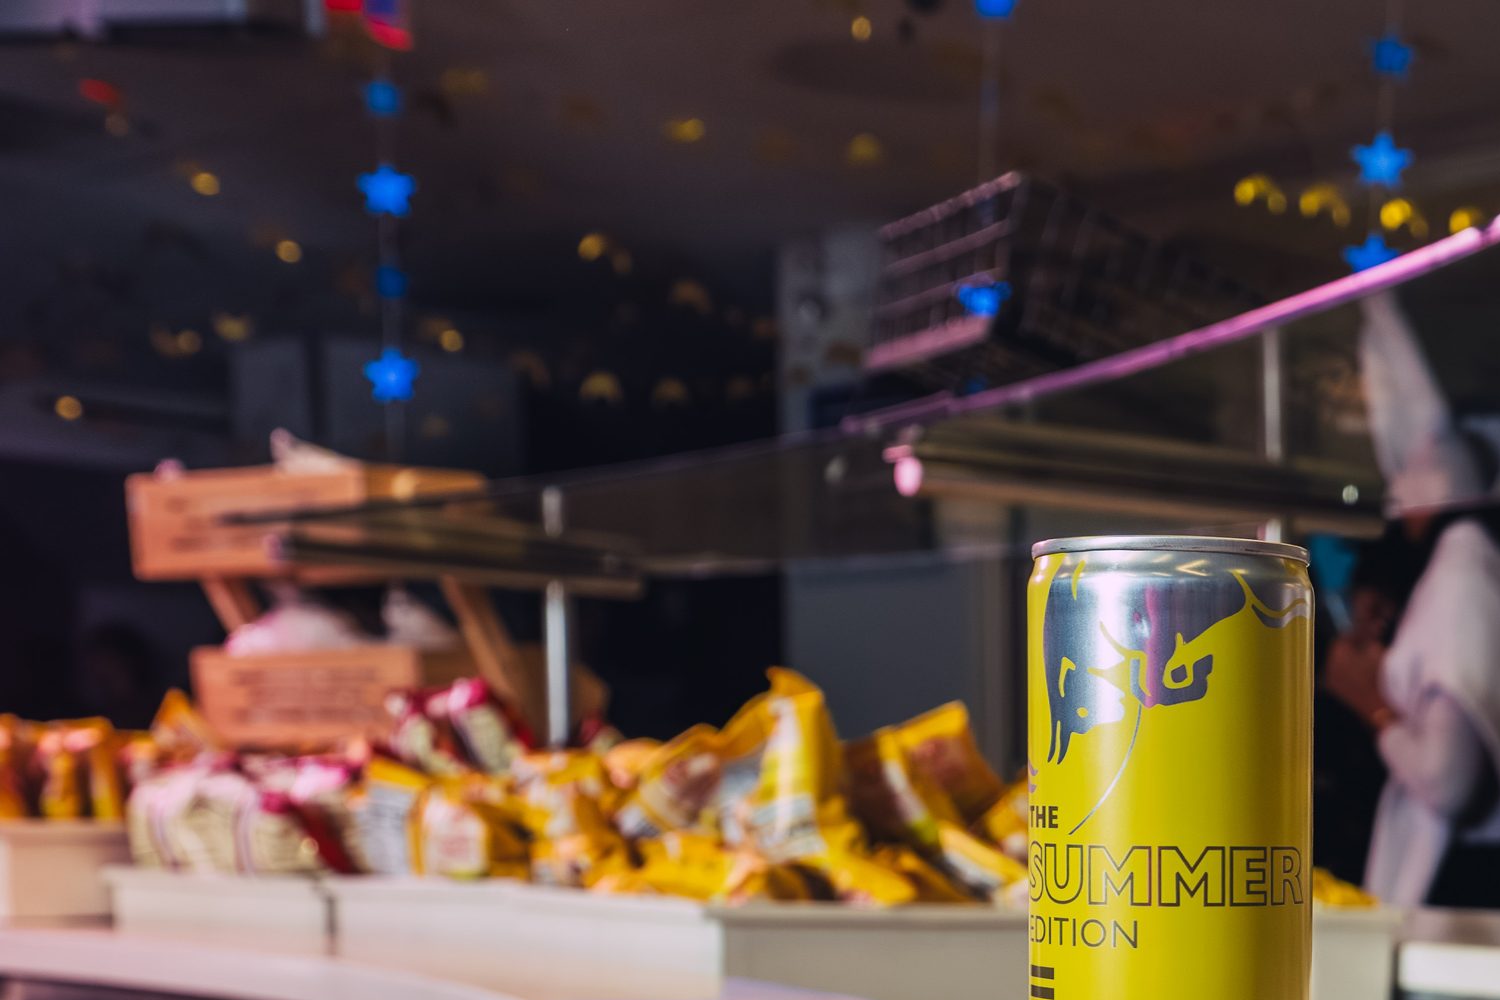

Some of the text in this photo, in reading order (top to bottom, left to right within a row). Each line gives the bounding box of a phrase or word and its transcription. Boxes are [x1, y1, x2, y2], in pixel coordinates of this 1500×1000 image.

[1029, 805, 1059, 829] THE
[1029, 840, 1305, 908] SUMMER
[1029, 916, 1139, 949] EDITION
